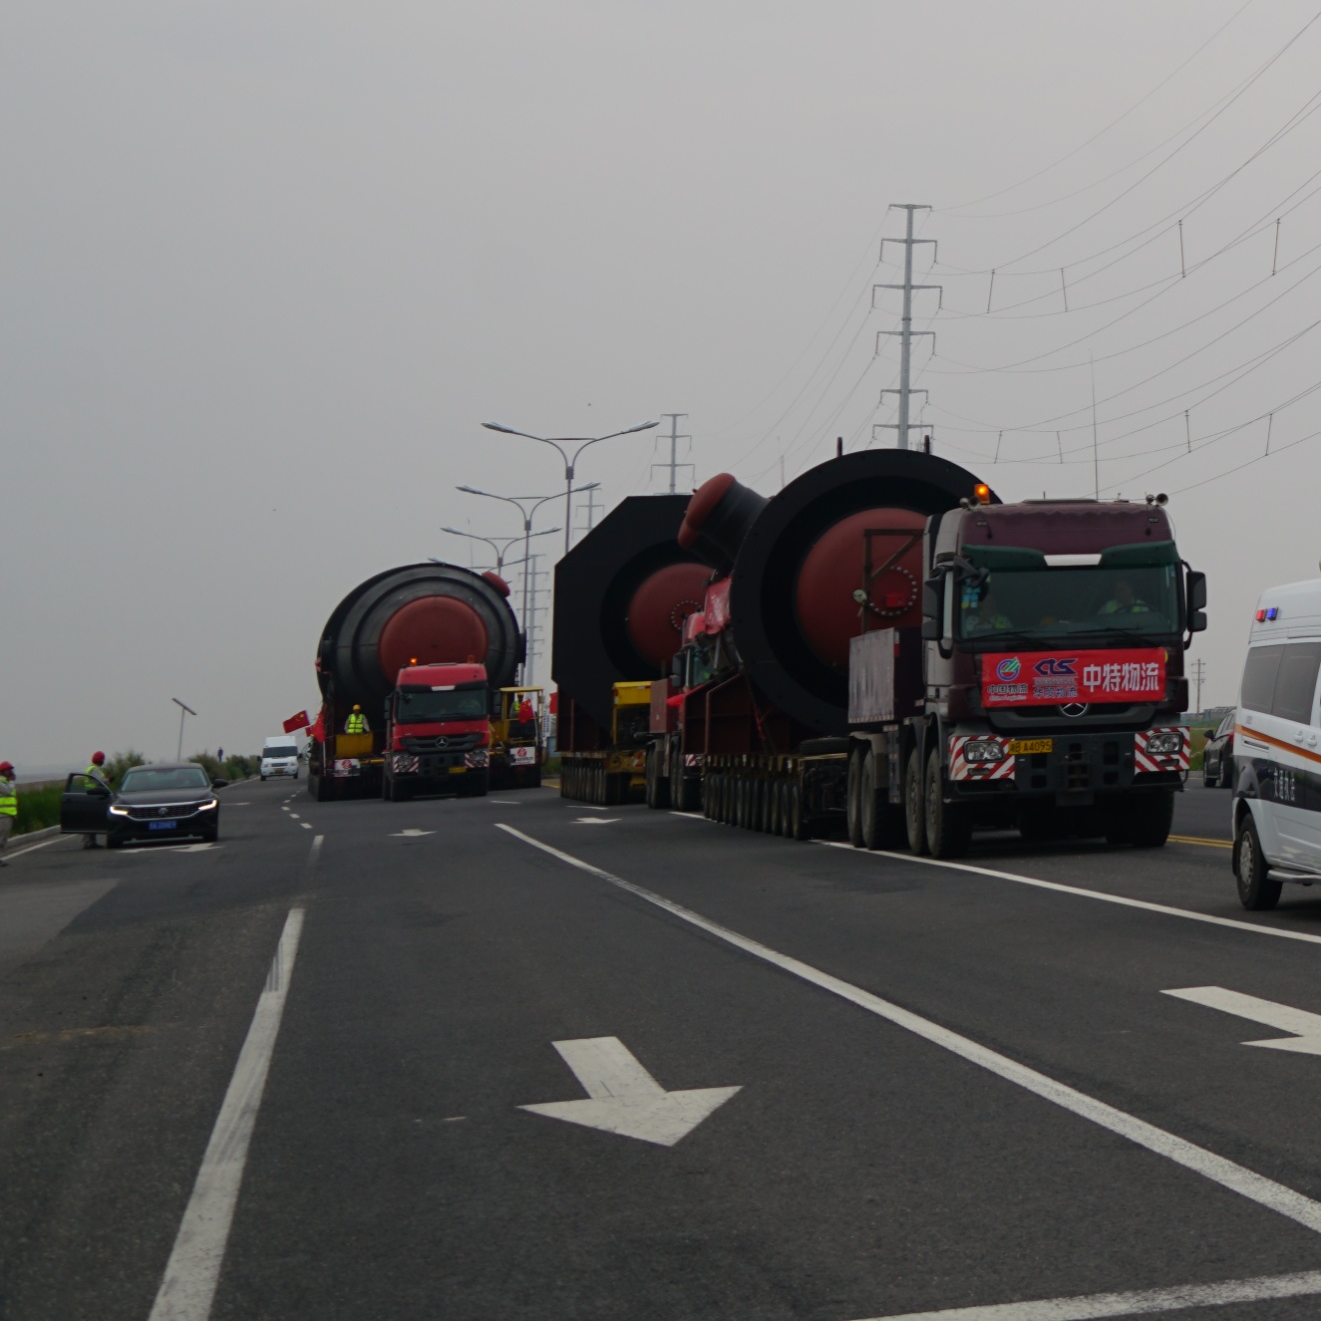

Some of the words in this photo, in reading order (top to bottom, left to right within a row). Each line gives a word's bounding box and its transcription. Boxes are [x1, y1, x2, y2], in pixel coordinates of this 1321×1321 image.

[1083, 662, 1160, 692] 中特物流
[987, 683, 1029, 695] 中国物流
